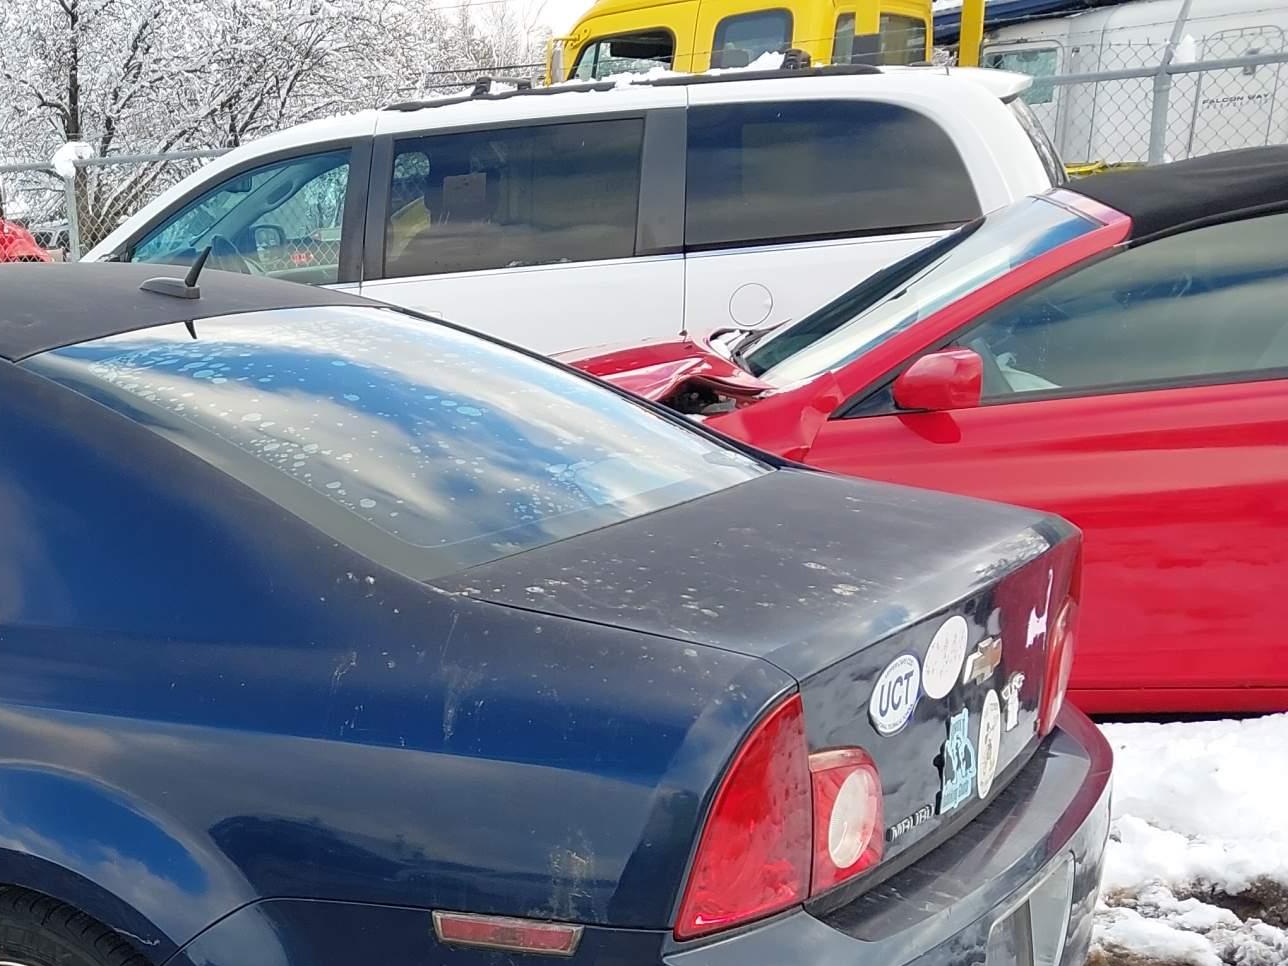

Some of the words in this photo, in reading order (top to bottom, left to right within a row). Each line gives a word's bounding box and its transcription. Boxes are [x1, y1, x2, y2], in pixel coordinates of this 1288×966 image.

[1202, 96, 1244, 104] FALCON
[1247, 92, 1270, 100] WAY
[879, 669, 915, 718] UCT
